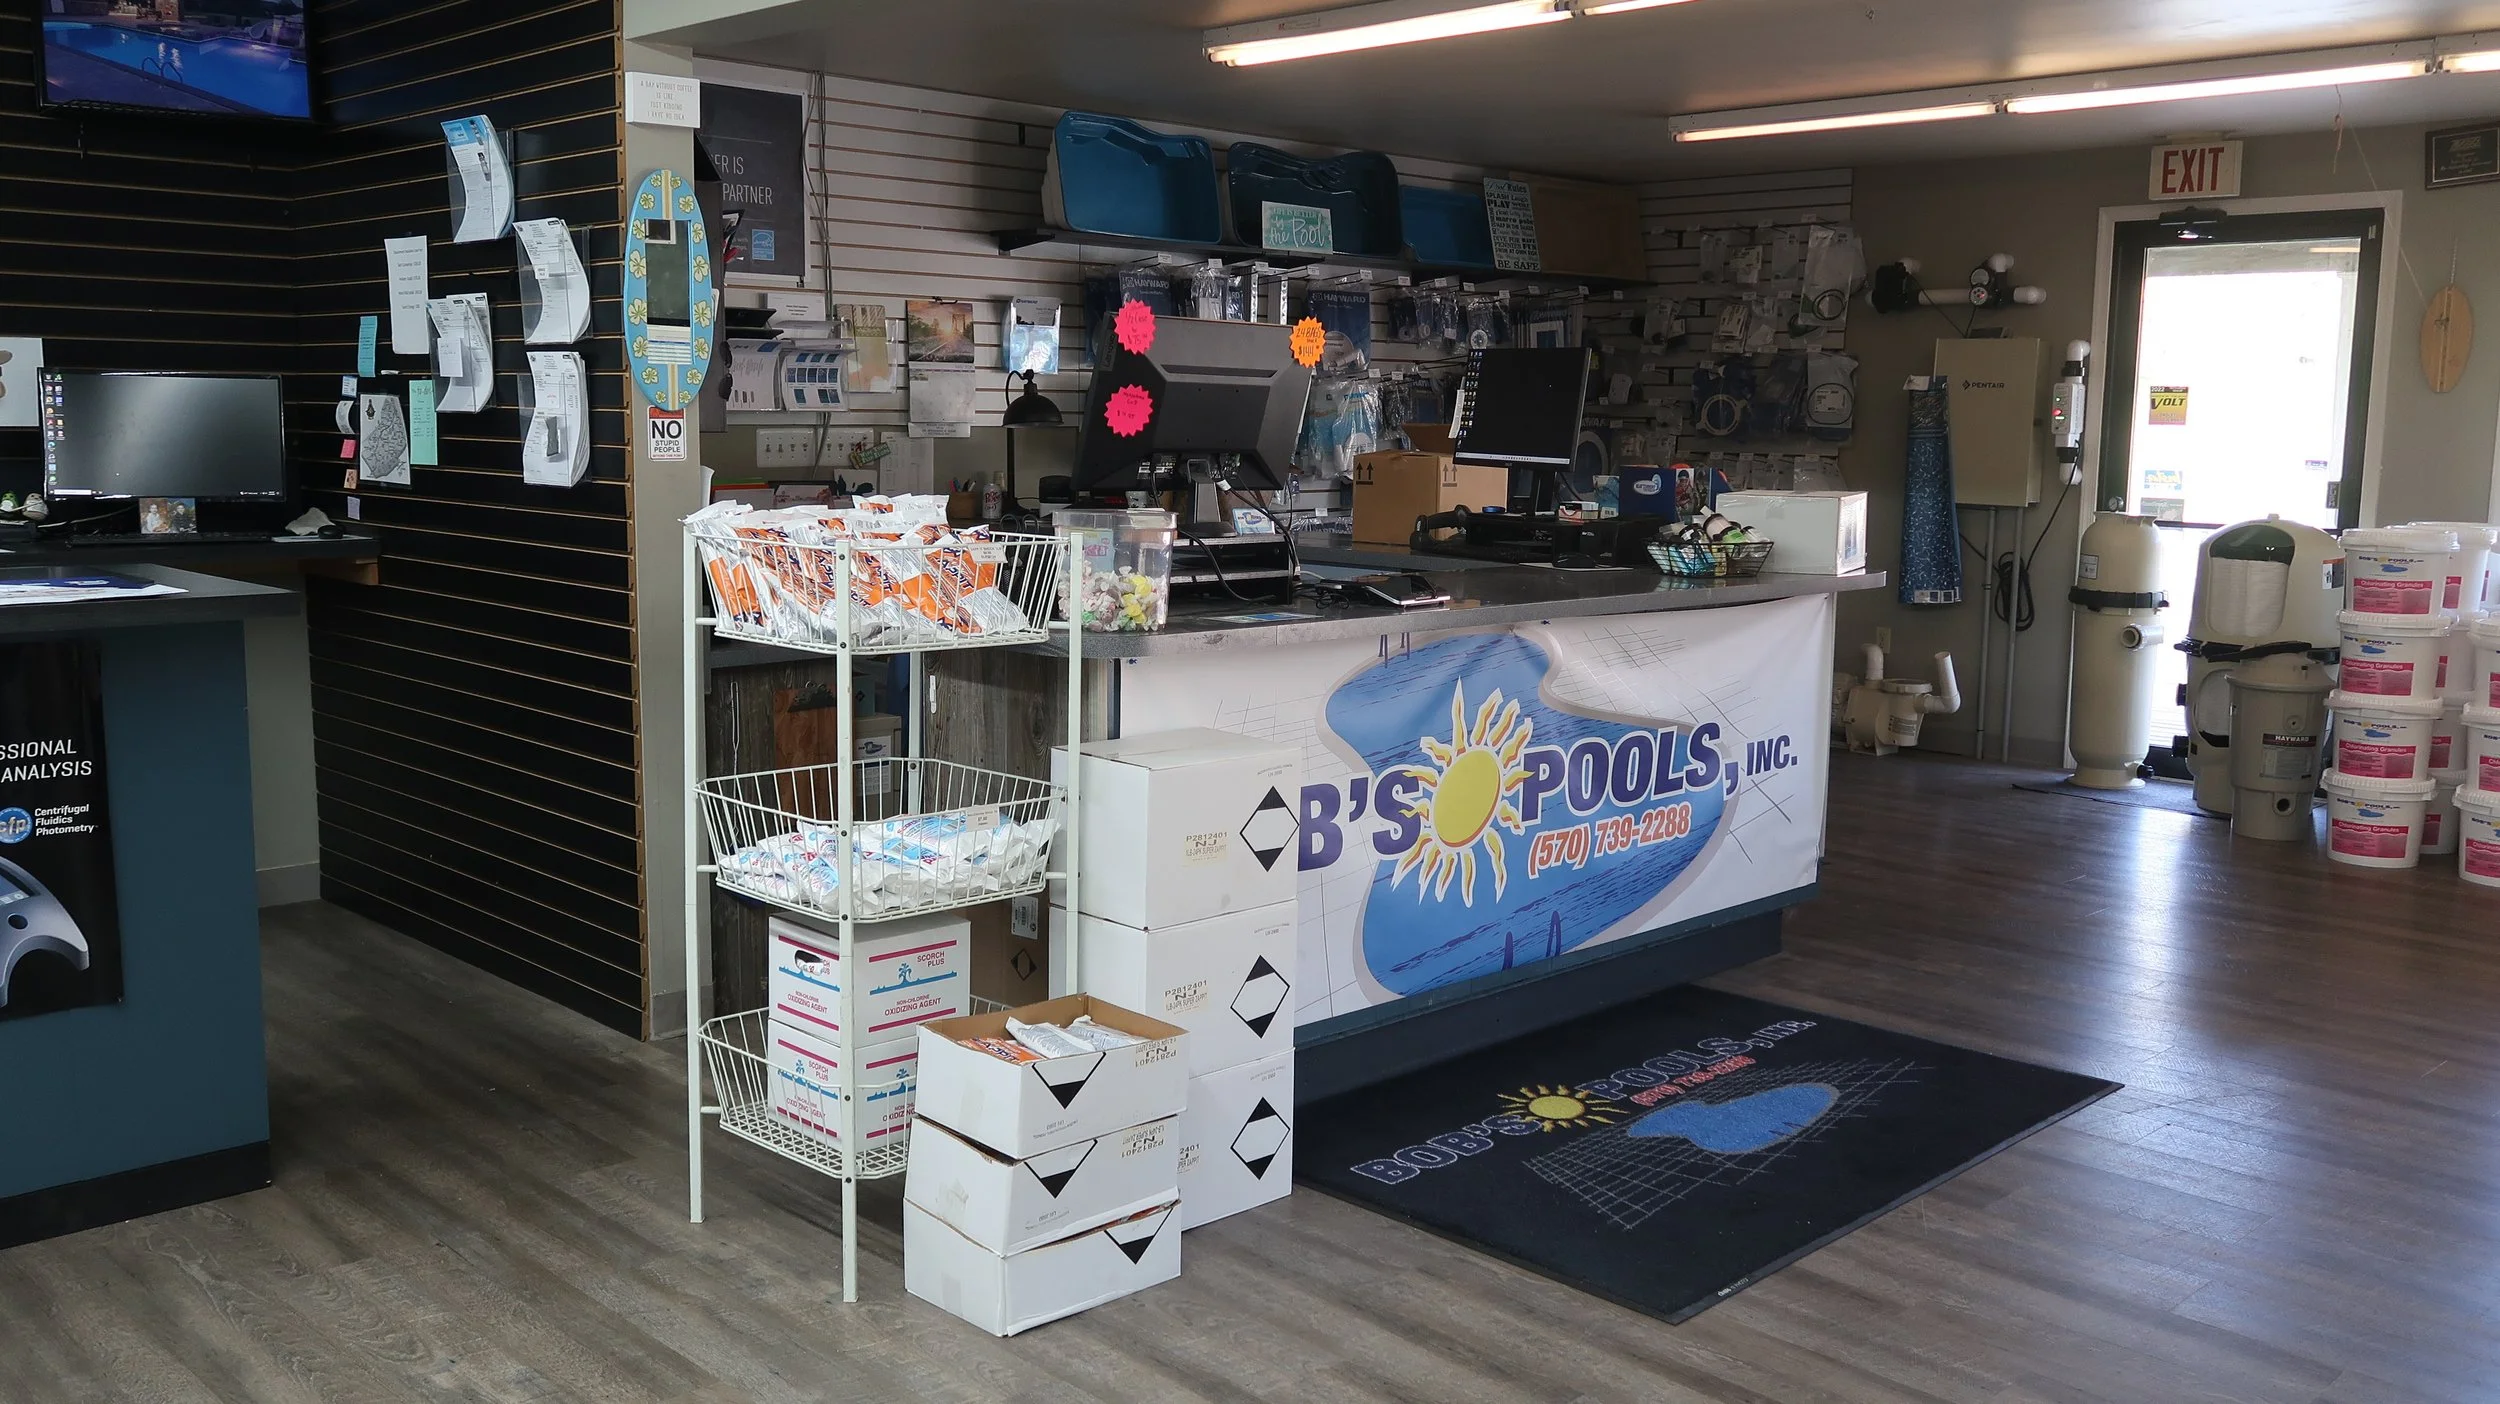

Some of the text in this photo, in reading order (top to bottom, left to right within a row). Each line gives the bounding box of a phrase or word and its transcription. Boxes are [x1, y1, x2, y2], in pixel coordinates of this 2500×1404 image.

[733, 156, 744, 175] IS
[2161, 147, 2225, 194] EXIT
[722, 182, 773, 205] PARTNER
[1507, 183, 1527, 193] Rules
[1486, 192, 1509, 200] SPLASH
[1487, 199, 1510, 208] PLAY
[1270, 213, 1325, 248] the Pool
[1497, 259, 1540, 271] BE SAFE
[1134, 278, 1170, 289] HAYWARD
[1323, 293, 1366, 304] HAYWARD
[1971, 381, 2006, 389] PENTAIR
[2150, 398, 2186, 410] VOLT
[652, 420, 682, 439] NO
[2360, 580, 2396, 588] Chlorinating
[2345, 659, 2403, 670] Chlorinating Granules
[2345, 742, 2407, 753] Chlorinating Granules
[0, 761, 92, 783] ANALYSIS
[1521, 722, 1740, 822] POOLS,
[1746, 735, 1798, 777] INC.
[34, 803, 89, 818] Centrifugal
[35, 815, 73, 827] Fluidics
[2338, 821, 2400, 833] Chlorinating Granules
[36, 824, 95, 837] Photometry
[1186, 831, 1228, 842] P2812401
[1195, 839, 1217, 847] NJ
[1529, 803, 1692, 878] (570) 739-2288
[917, 951, 945, 963] SCORCH
[927, 959, 945, 968] PLUS
[1164, 979, 1207, 998] P2812401
[1174, 989, 1197, 1001] NJ
[787, 993, 828, 1014] OXIDIZING AGENT
[896, 993, 930, 1006] NON-CHLORINE
[884, 997, 942, 1017] OXIDIZING AGENT
[1146, 1045, 1168, 1058] NJ
[1135, 1049, 1177, 1068] P2812401
[808, 1061, 829, 1075] SCORCH
[815, 1070, 829, 1081] PLUS
[1133, 1135, 1155, 1148] NJ
[1121, 1139, 1164, 1158] P2812401
[1350, 1113, 1542, 1185] BOB'S
